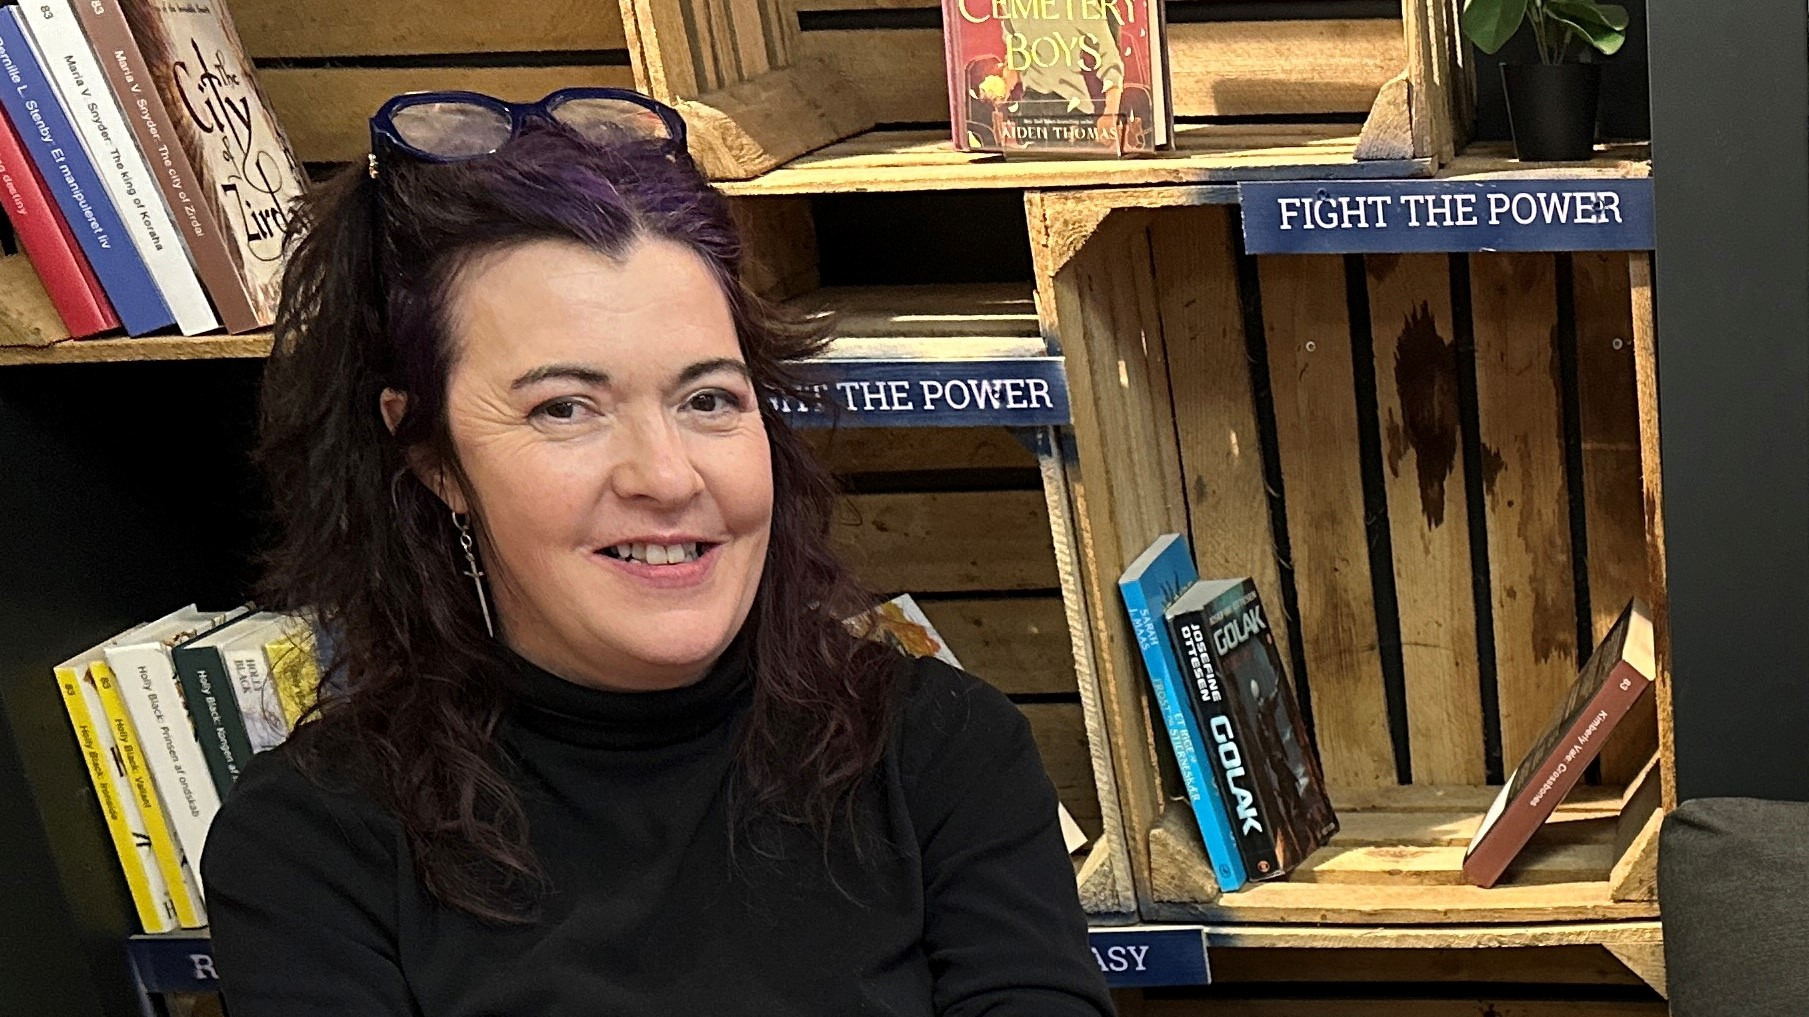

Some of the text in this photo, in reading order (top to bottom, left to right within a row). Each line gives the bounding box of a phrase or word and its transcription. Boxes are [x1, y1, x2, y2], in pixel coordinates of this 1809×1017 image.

[41, 5, 54, 20] 83
[115, 50, 134, 84] Maria
[1006, 32, 1102, 72] BOYS
[64, 55, 84, 90] Maria
[110, 148, 124, 171] The
[120, 171, 136, 196] king
[133, 197, 143, 209] of
[1001, 126, 1118, 141] AIDEN THOMAS
[158, 144, 171, 166] The
[168, 168, 183, 190] city
[179, 191, 191, 204] of
[51, 148, 64, 165] Et
[59, 164, 104, 235] manipuleret
[97, 233, 111, 250] liv
[1277, 191, 1623, 230] FIGHT THE POWER
[184, 204, 204, 238] Zirdal
[836, 380, 914, 411] THE
[919, 378, 1054, 410] POWER
[1133, 618, 1151, 651] MAAS
[1139, 608, 1159, 646] SARAH
[1213, 605, 1267, 657] GOLAK
[1180, 625, 1211, 703] OTTESEN
[1191, 623, 1222, 703] JOSEFINE
[197, 670, 211, 696] Holly
[136, 665, 153, 691] Holly
[160, 726, 179, 763] Prinsen
[179, 777, 200, 818] ondskab
[1577, 709, 1608, 746] Kimberly
[1210, 715, 1263, 837] GOLAK
[1529, 763, 1568, 808] Crossbones
